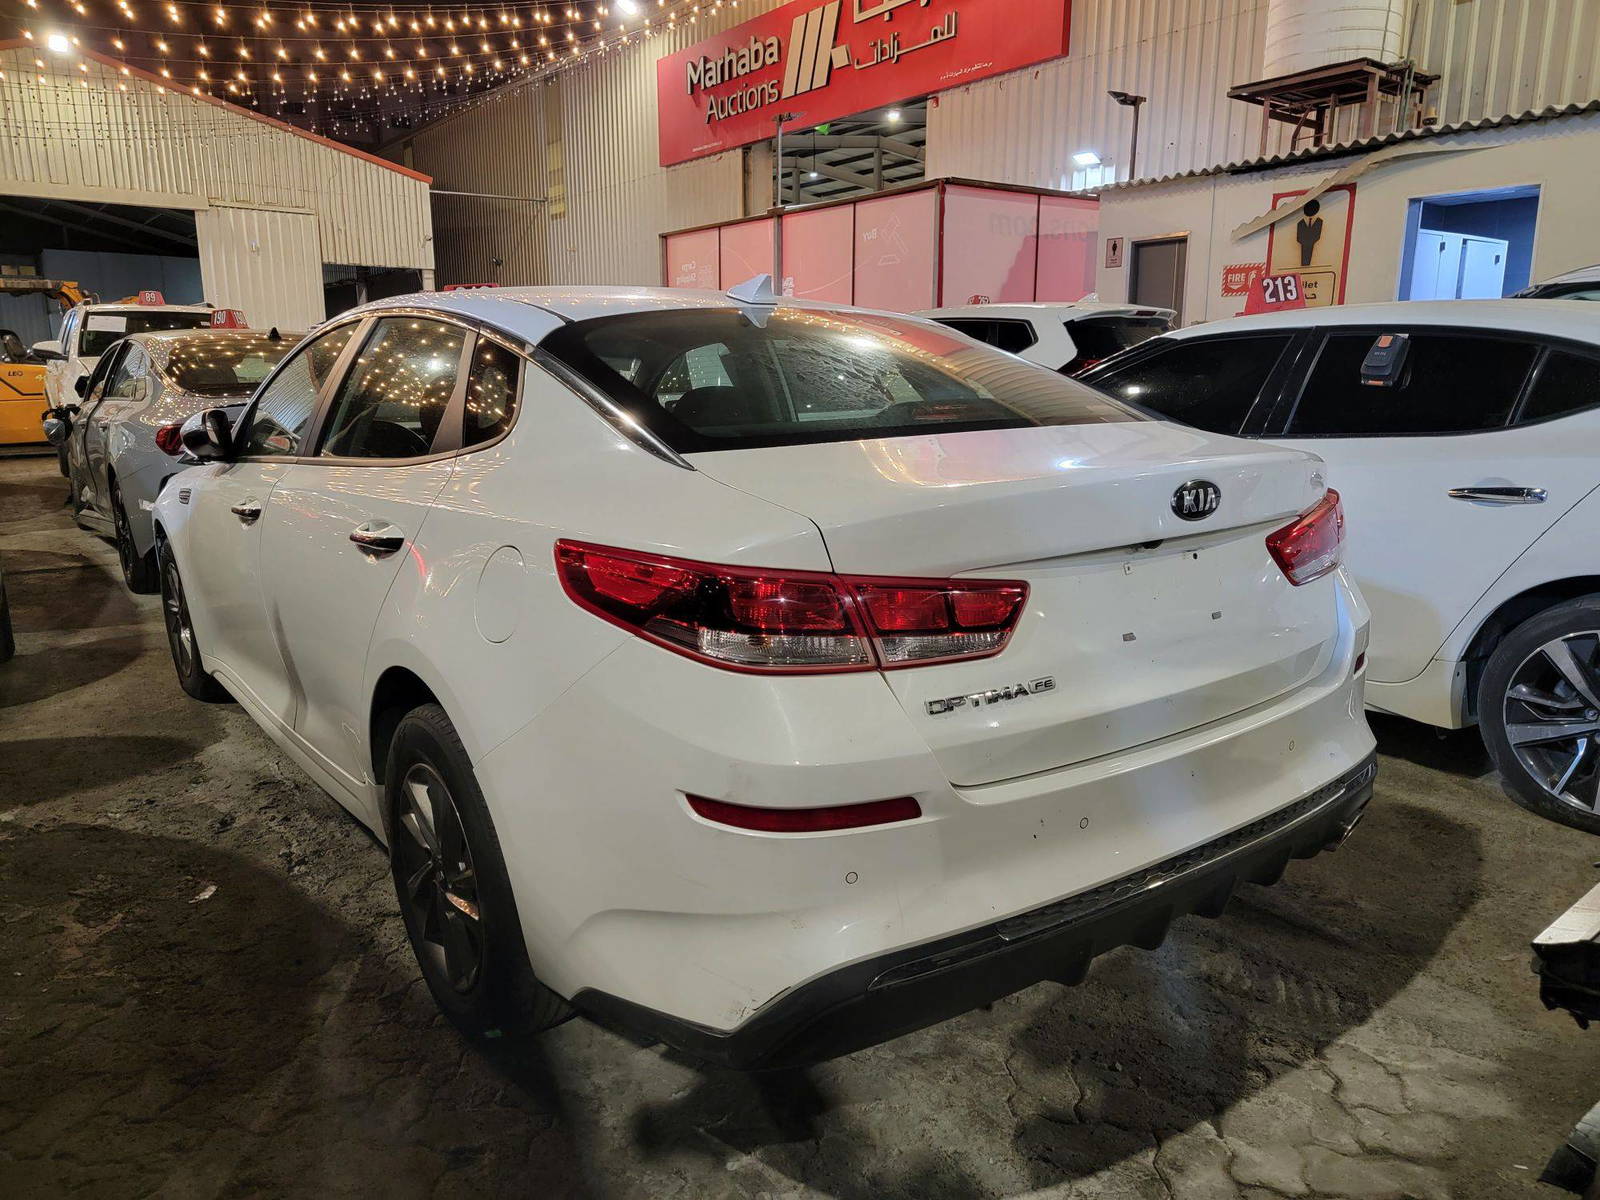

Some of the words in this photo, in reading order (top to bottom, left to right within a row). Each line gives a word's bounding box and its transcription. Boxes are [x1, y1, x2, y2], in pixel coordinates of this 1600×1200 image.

[686, 35, 780, 95] Marhaba
[705, 80, 779, 124] Auctions
[1227, 272, 1246, 283] FIRE
[1262, 275, 1297, 304] 213
[145, 292, 156, 302] 89
[213, 311, 226, 325] 190
[1183, 487, 1217, 513] KIA
[925, 683, 1030, 715] OPTIMA
[1034, 679, 1053, 691] FE
